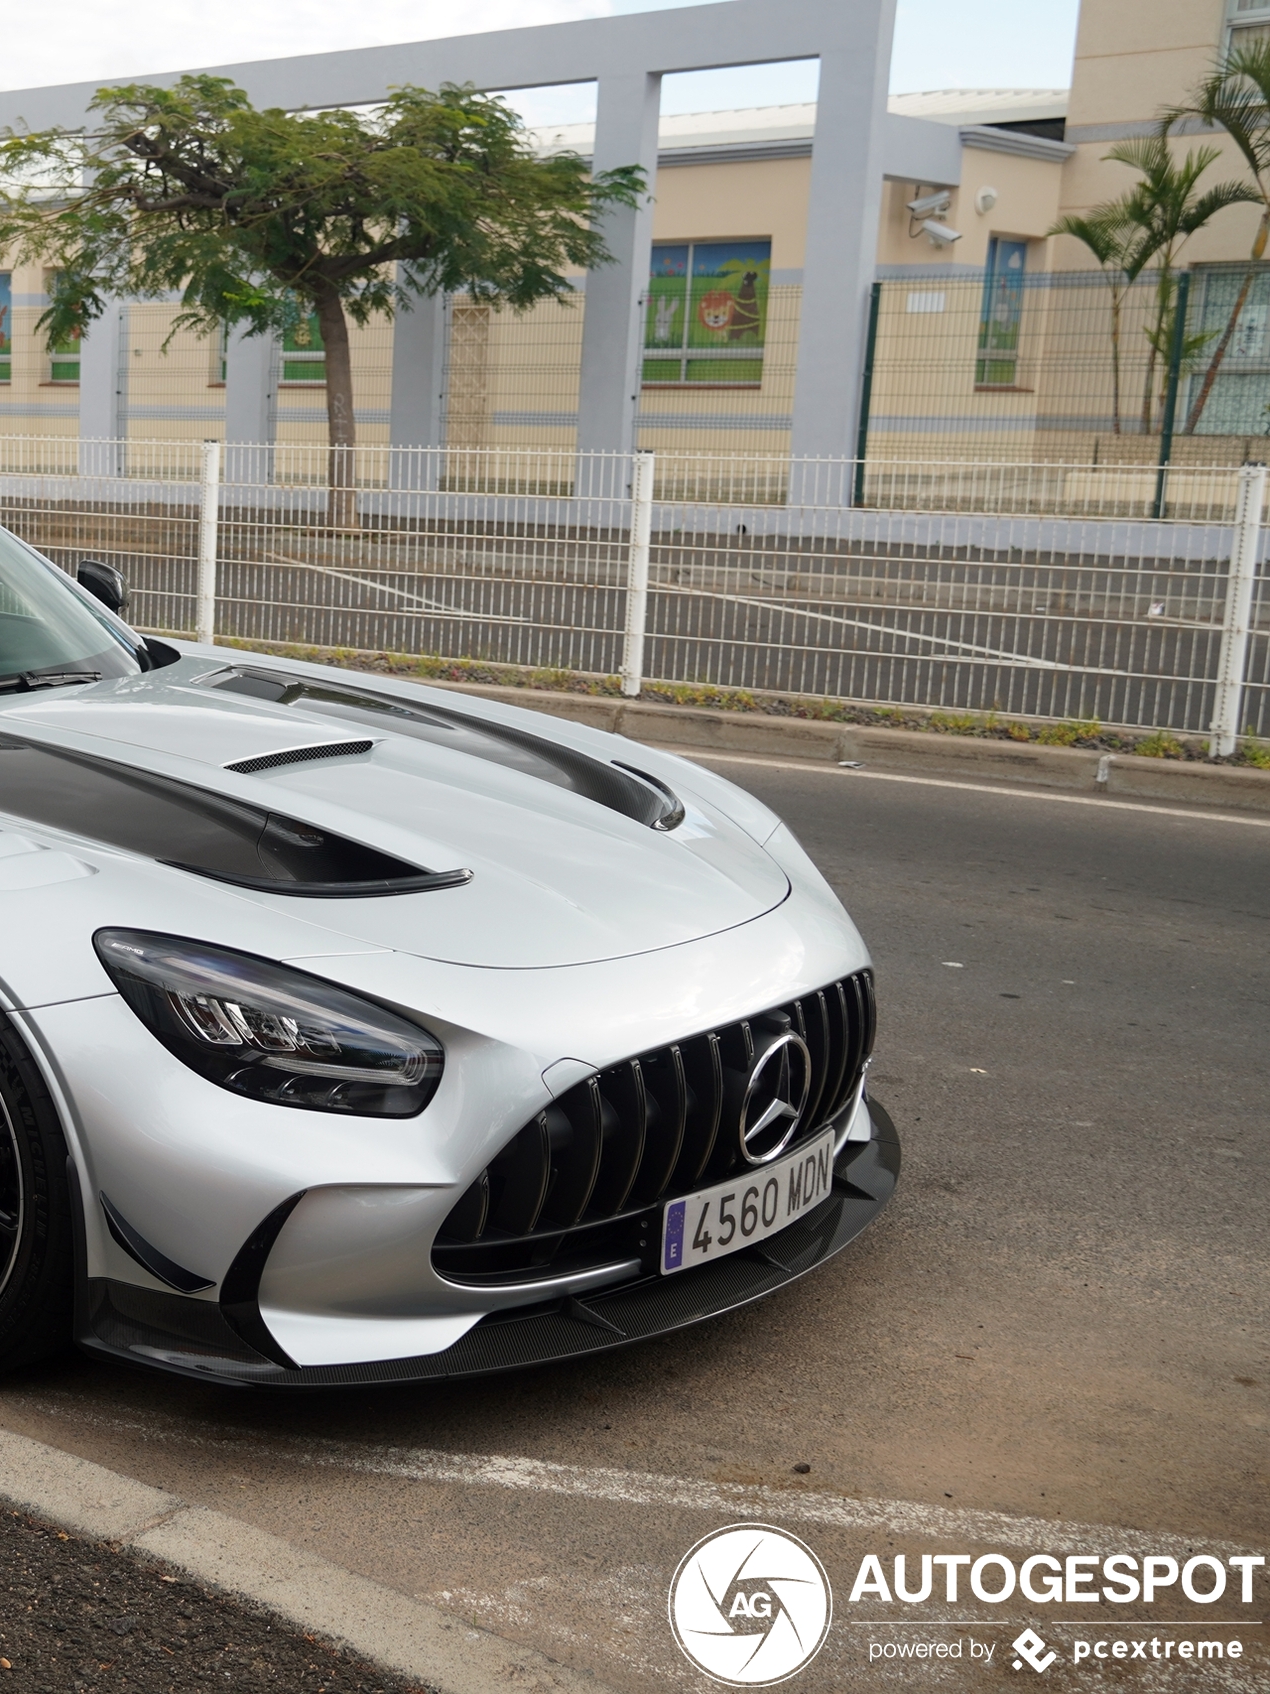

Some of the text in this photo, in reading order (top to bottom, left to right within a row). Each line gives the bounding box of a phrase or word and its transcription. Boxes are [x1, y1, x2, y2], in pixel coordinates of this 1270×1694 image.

[20, 1105, 49, 1239] MICHELIN
[670, 1143, 830, 1258] E 4560 MDN
